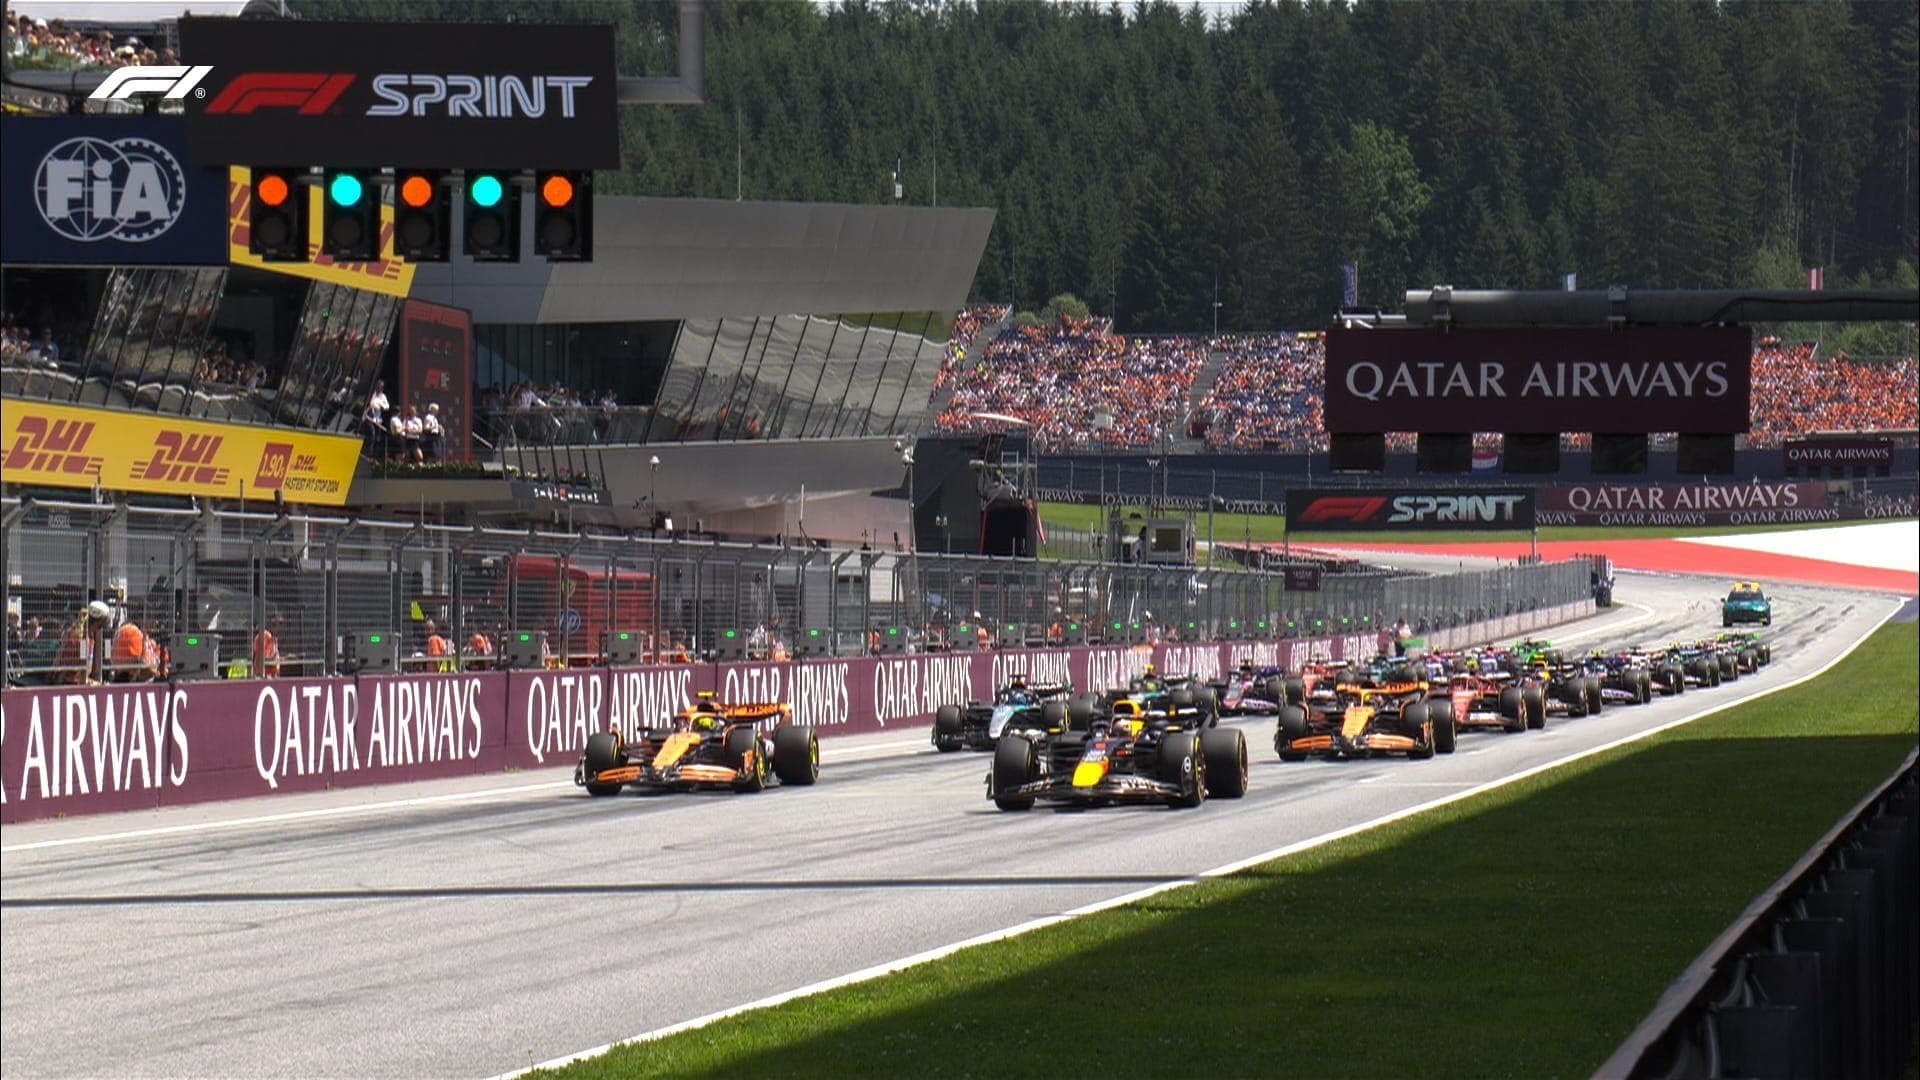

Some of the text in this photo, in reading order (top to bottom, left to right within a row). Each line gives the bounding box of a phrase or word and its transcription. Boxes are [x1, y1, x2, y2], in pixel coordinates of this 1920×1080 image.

[366, 74, 594, 119] SPRINT
[1345, 361, 1729, 400] QATAR AIRWAYS
[4, 416, 97, 474] DHL
[143, 430, 224, 484] DHL
[1788, 448, 1889, 460] QATAR AIRWAYS
[1225, 502, 1268, 513] QATAR
[1387, 495, 1526, 523] SPRINT
[1568, 484, 1799, 512] QATAR AIRWAYS
[1600, 511, 1706, 525] QATAR AIRWAYS
[1730, 506, 1840, 525] QATAR AIRWAYS
[1864, 503, 1912, 518] QATAR
[787, 662, 849, 727] AIRWAYS
[874, 655, 972, 727] QATAR AIRWAYS
[254, 678, 482, 789] QATAR AIRWAYS
[527, 674, 602, 764] QATAR
[20, 690, 189, 800] AIRWAYS
